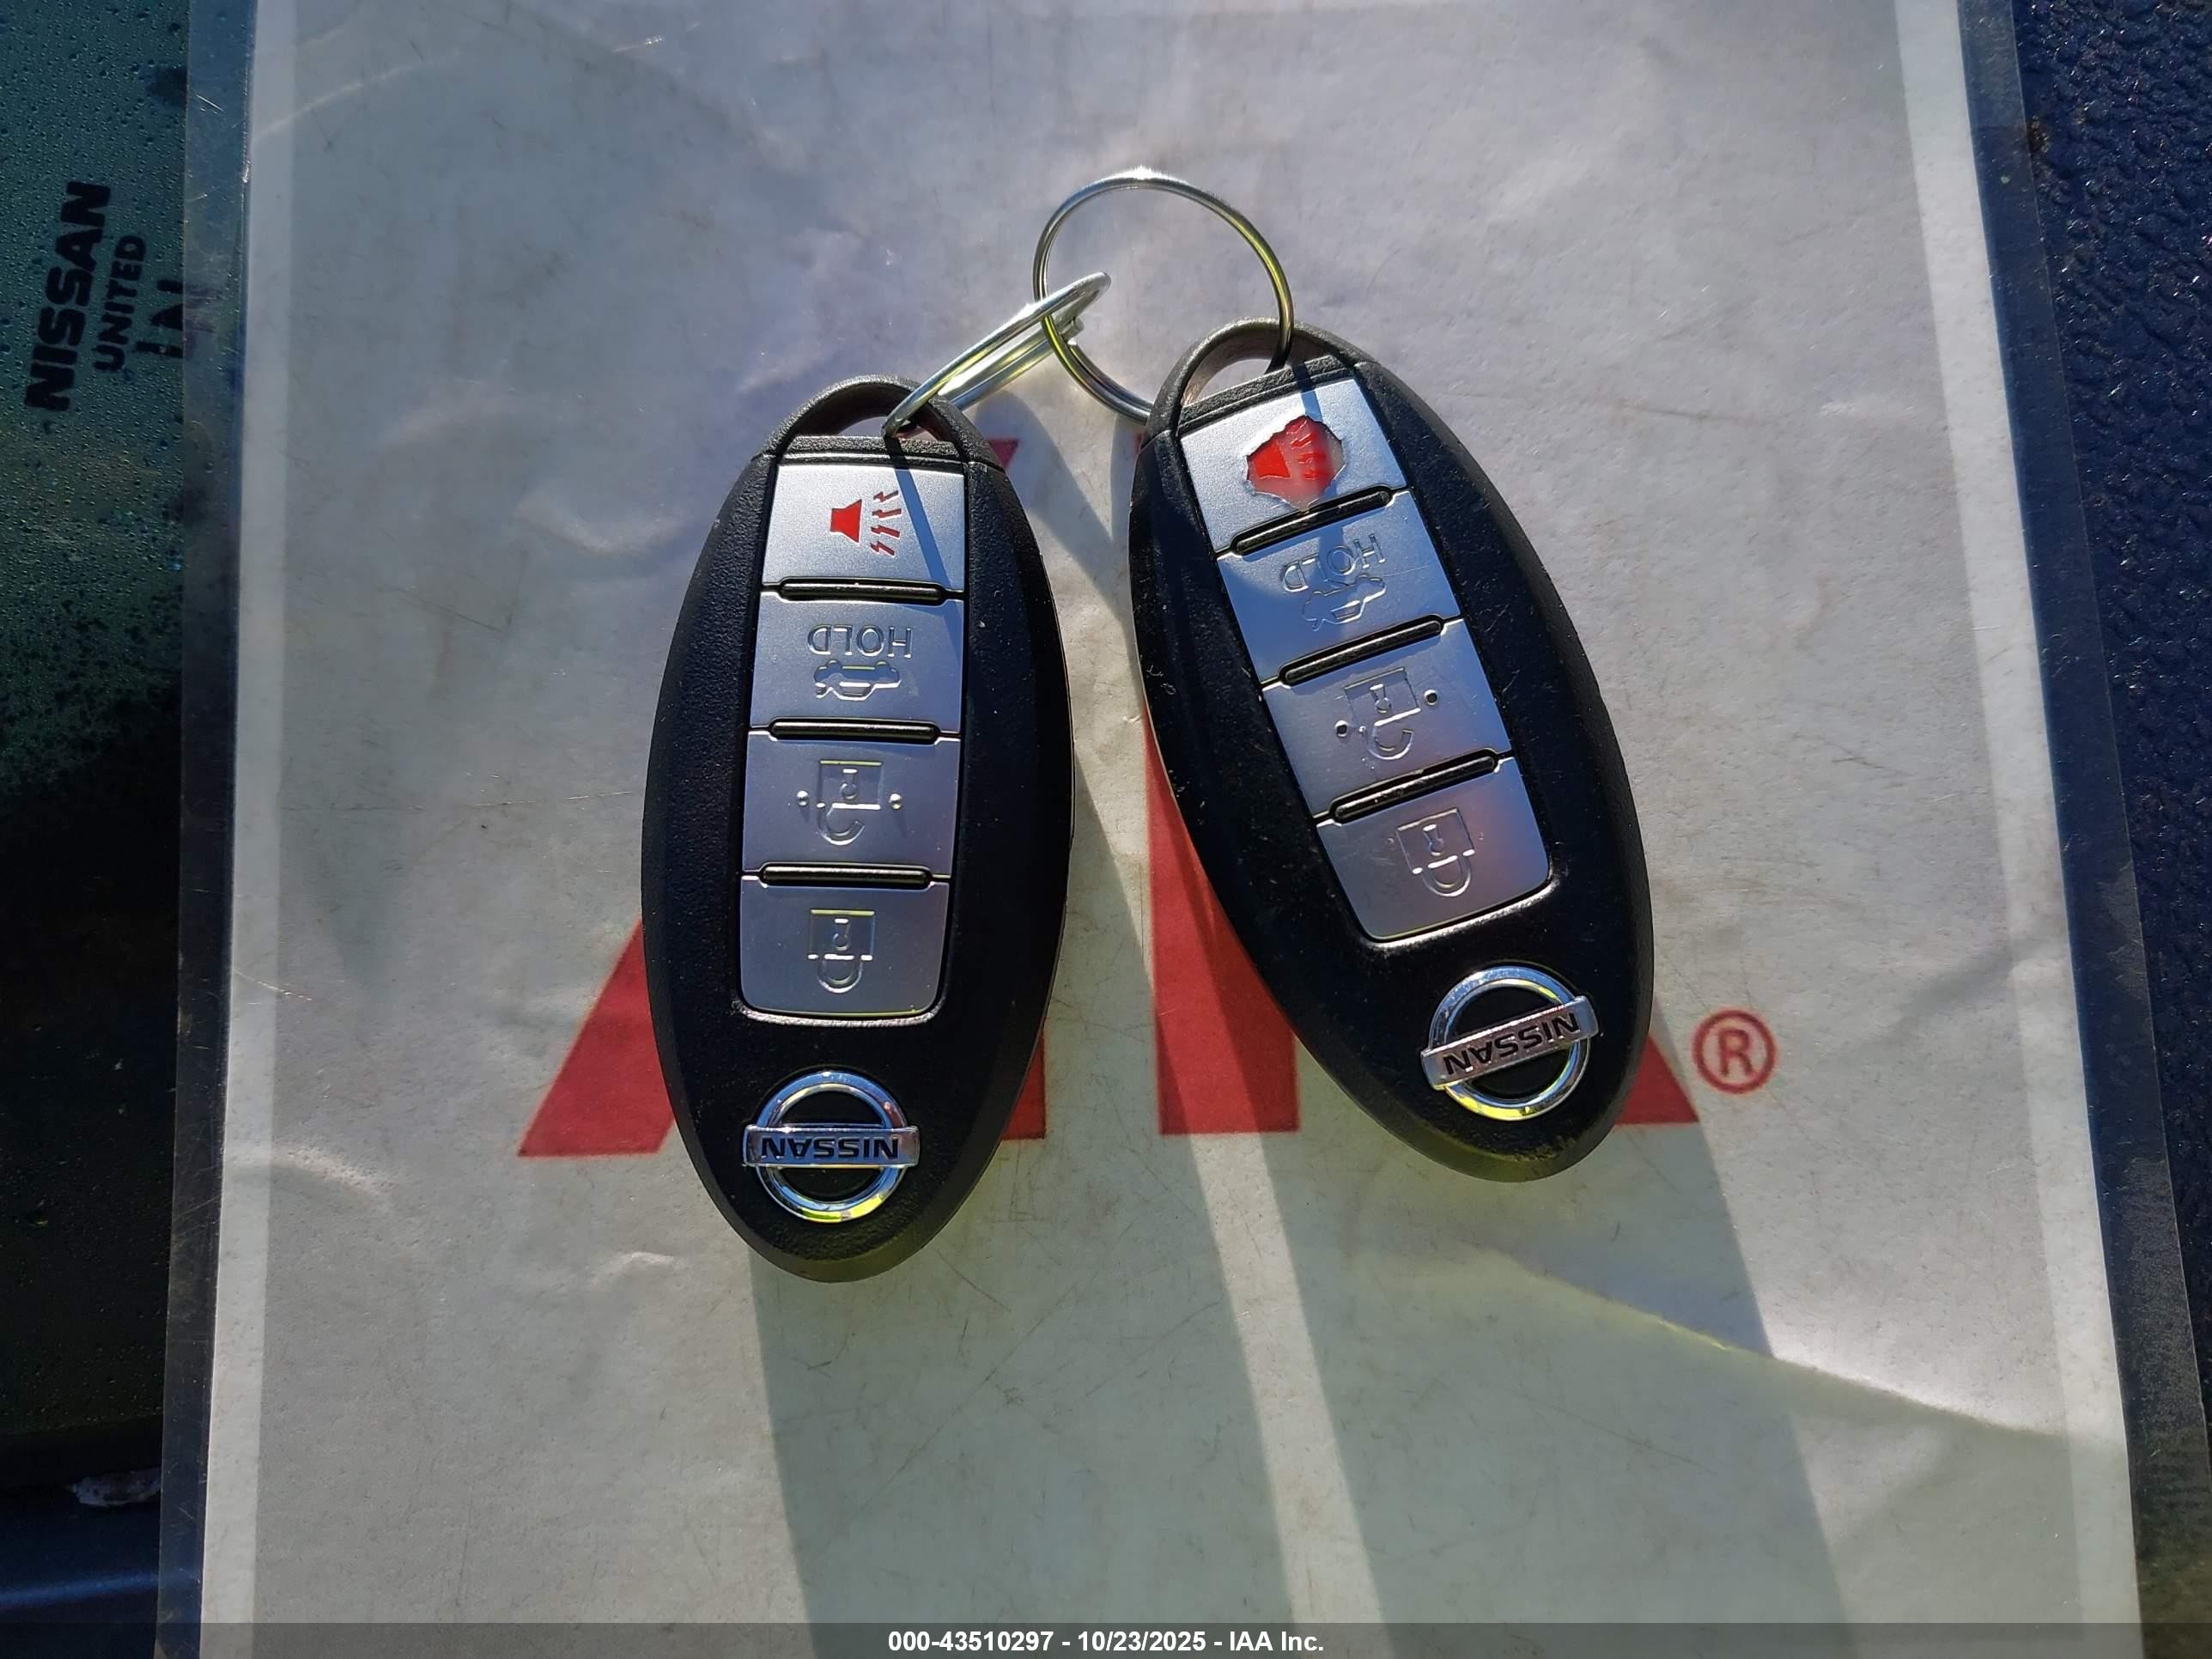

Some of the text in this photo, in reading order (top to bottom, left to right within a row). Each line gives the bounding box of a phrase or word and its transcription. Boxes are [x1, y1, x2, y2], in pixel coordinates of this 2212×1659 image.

[24, 181, 111, 412] NISSAN
[94, 234, 146, 372] UNITED
[1279, 533, 1386, 592] HOLD
[807, 623, 913, 659] HOLD
[1443, 1012, 1581, 1075] NISSAN
[761, 1136, 899, 1159] NISSAN
